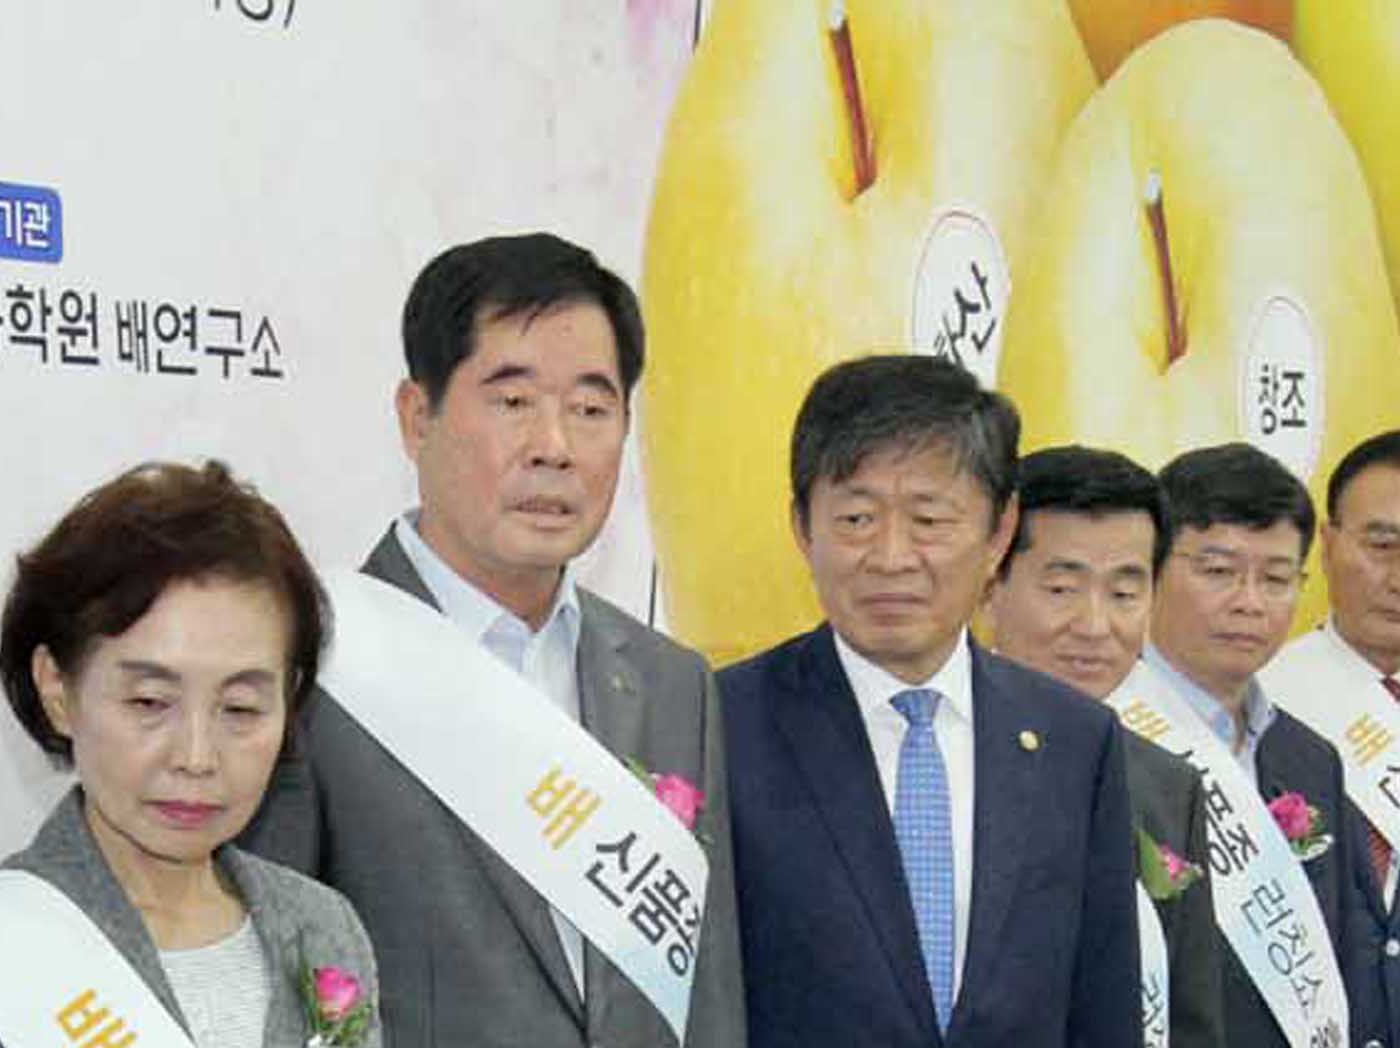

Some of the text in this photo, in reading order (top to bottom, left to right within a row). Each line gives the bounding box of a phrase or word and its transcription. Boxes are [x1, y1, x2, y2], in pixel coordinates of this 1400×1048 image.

[115, 299, 283, 378] 배연구소
[1258, 364, 1307, 435] 창조
[1345, 713, 1393, 767] 배
[526, 764, 600, 849] 배
